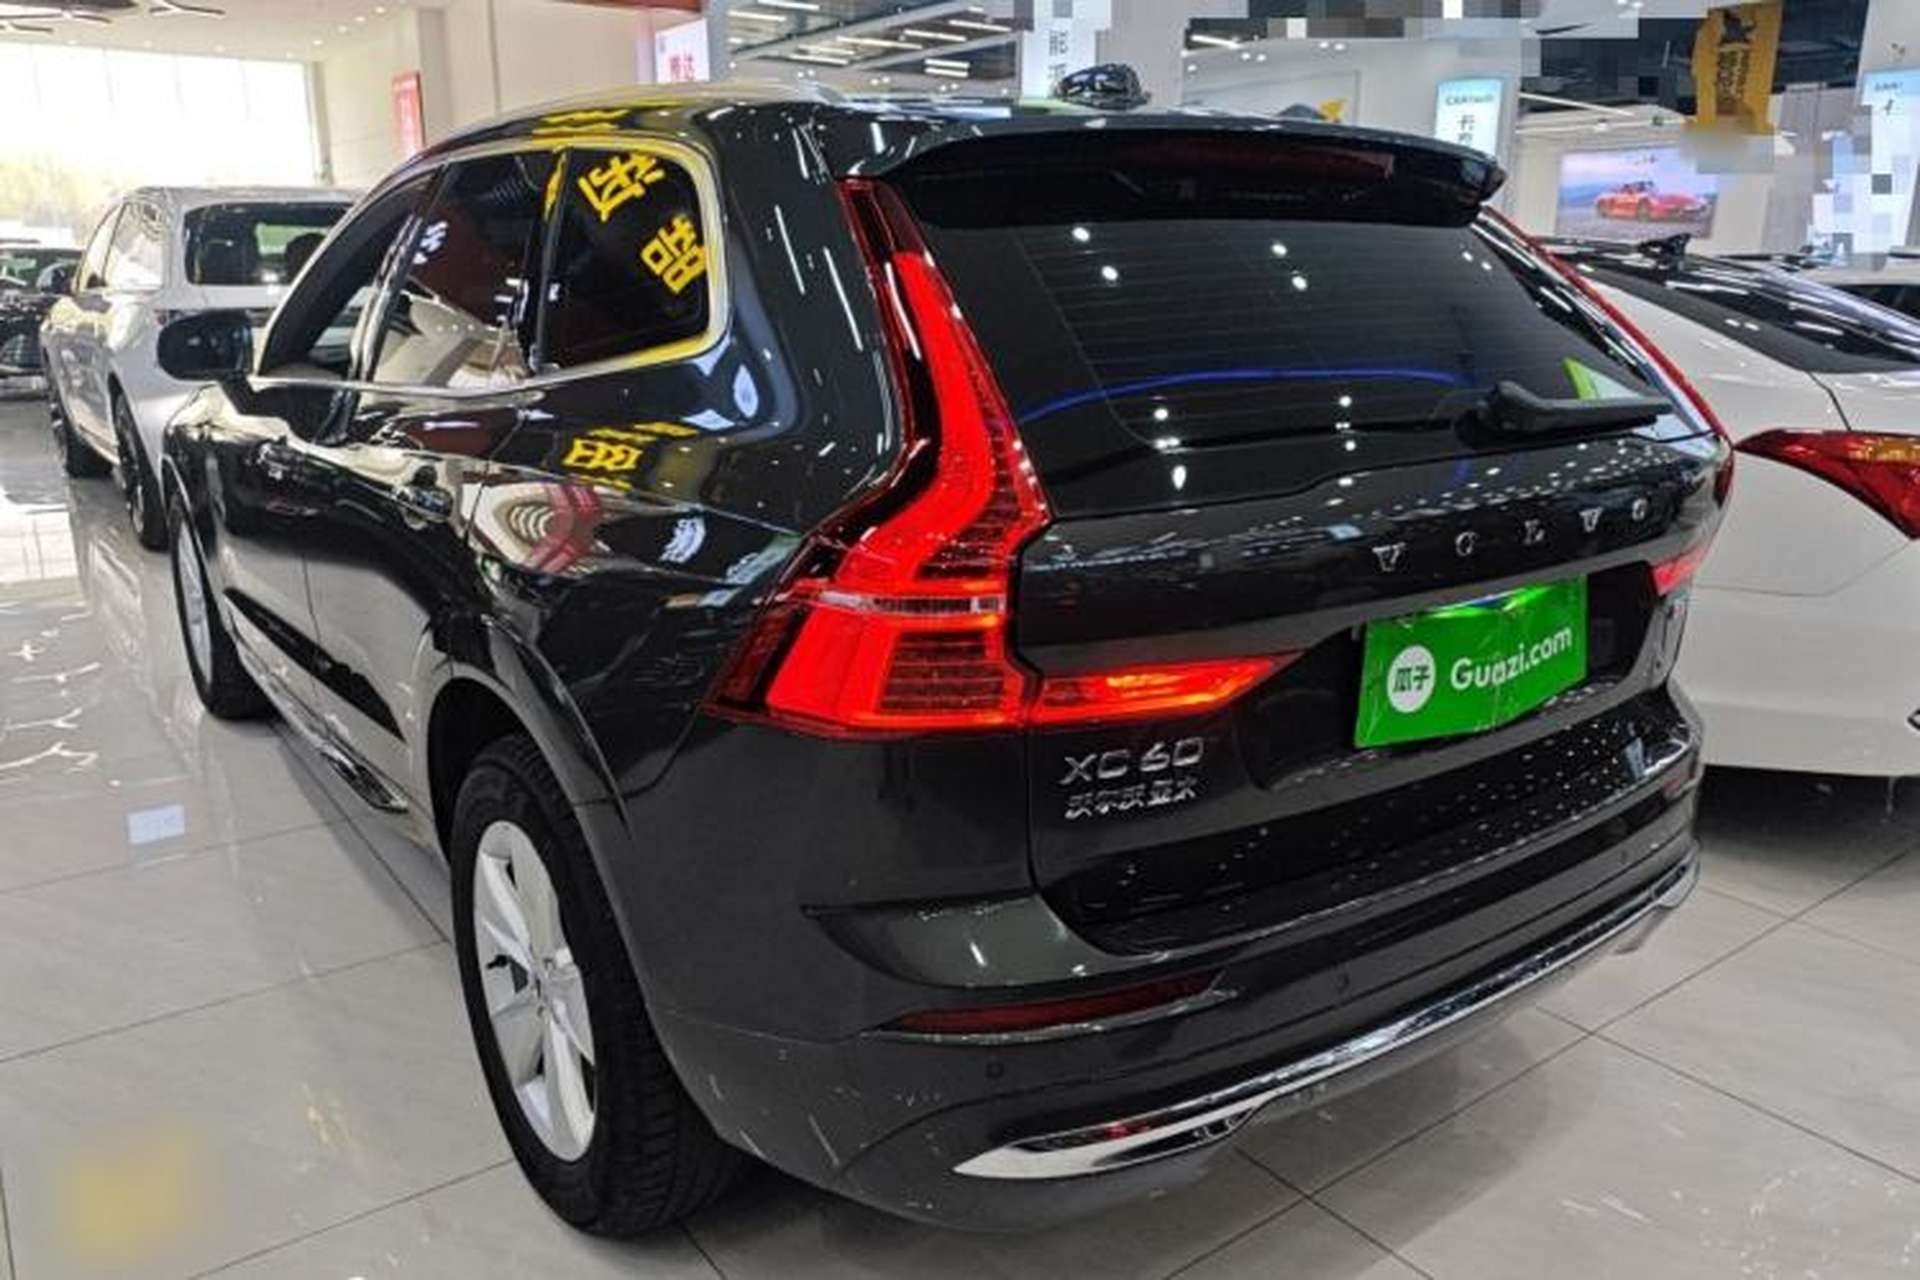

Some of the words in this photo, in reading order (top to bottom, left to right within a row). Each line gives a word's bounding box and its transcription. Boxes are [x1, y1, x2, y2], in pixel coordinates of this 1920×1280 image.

[1372, 498, 1648, 572] VOLVO
[1393, 665, 1431, 693] 瓜子
[1451, 627, 1573, 690] Guazi.com
